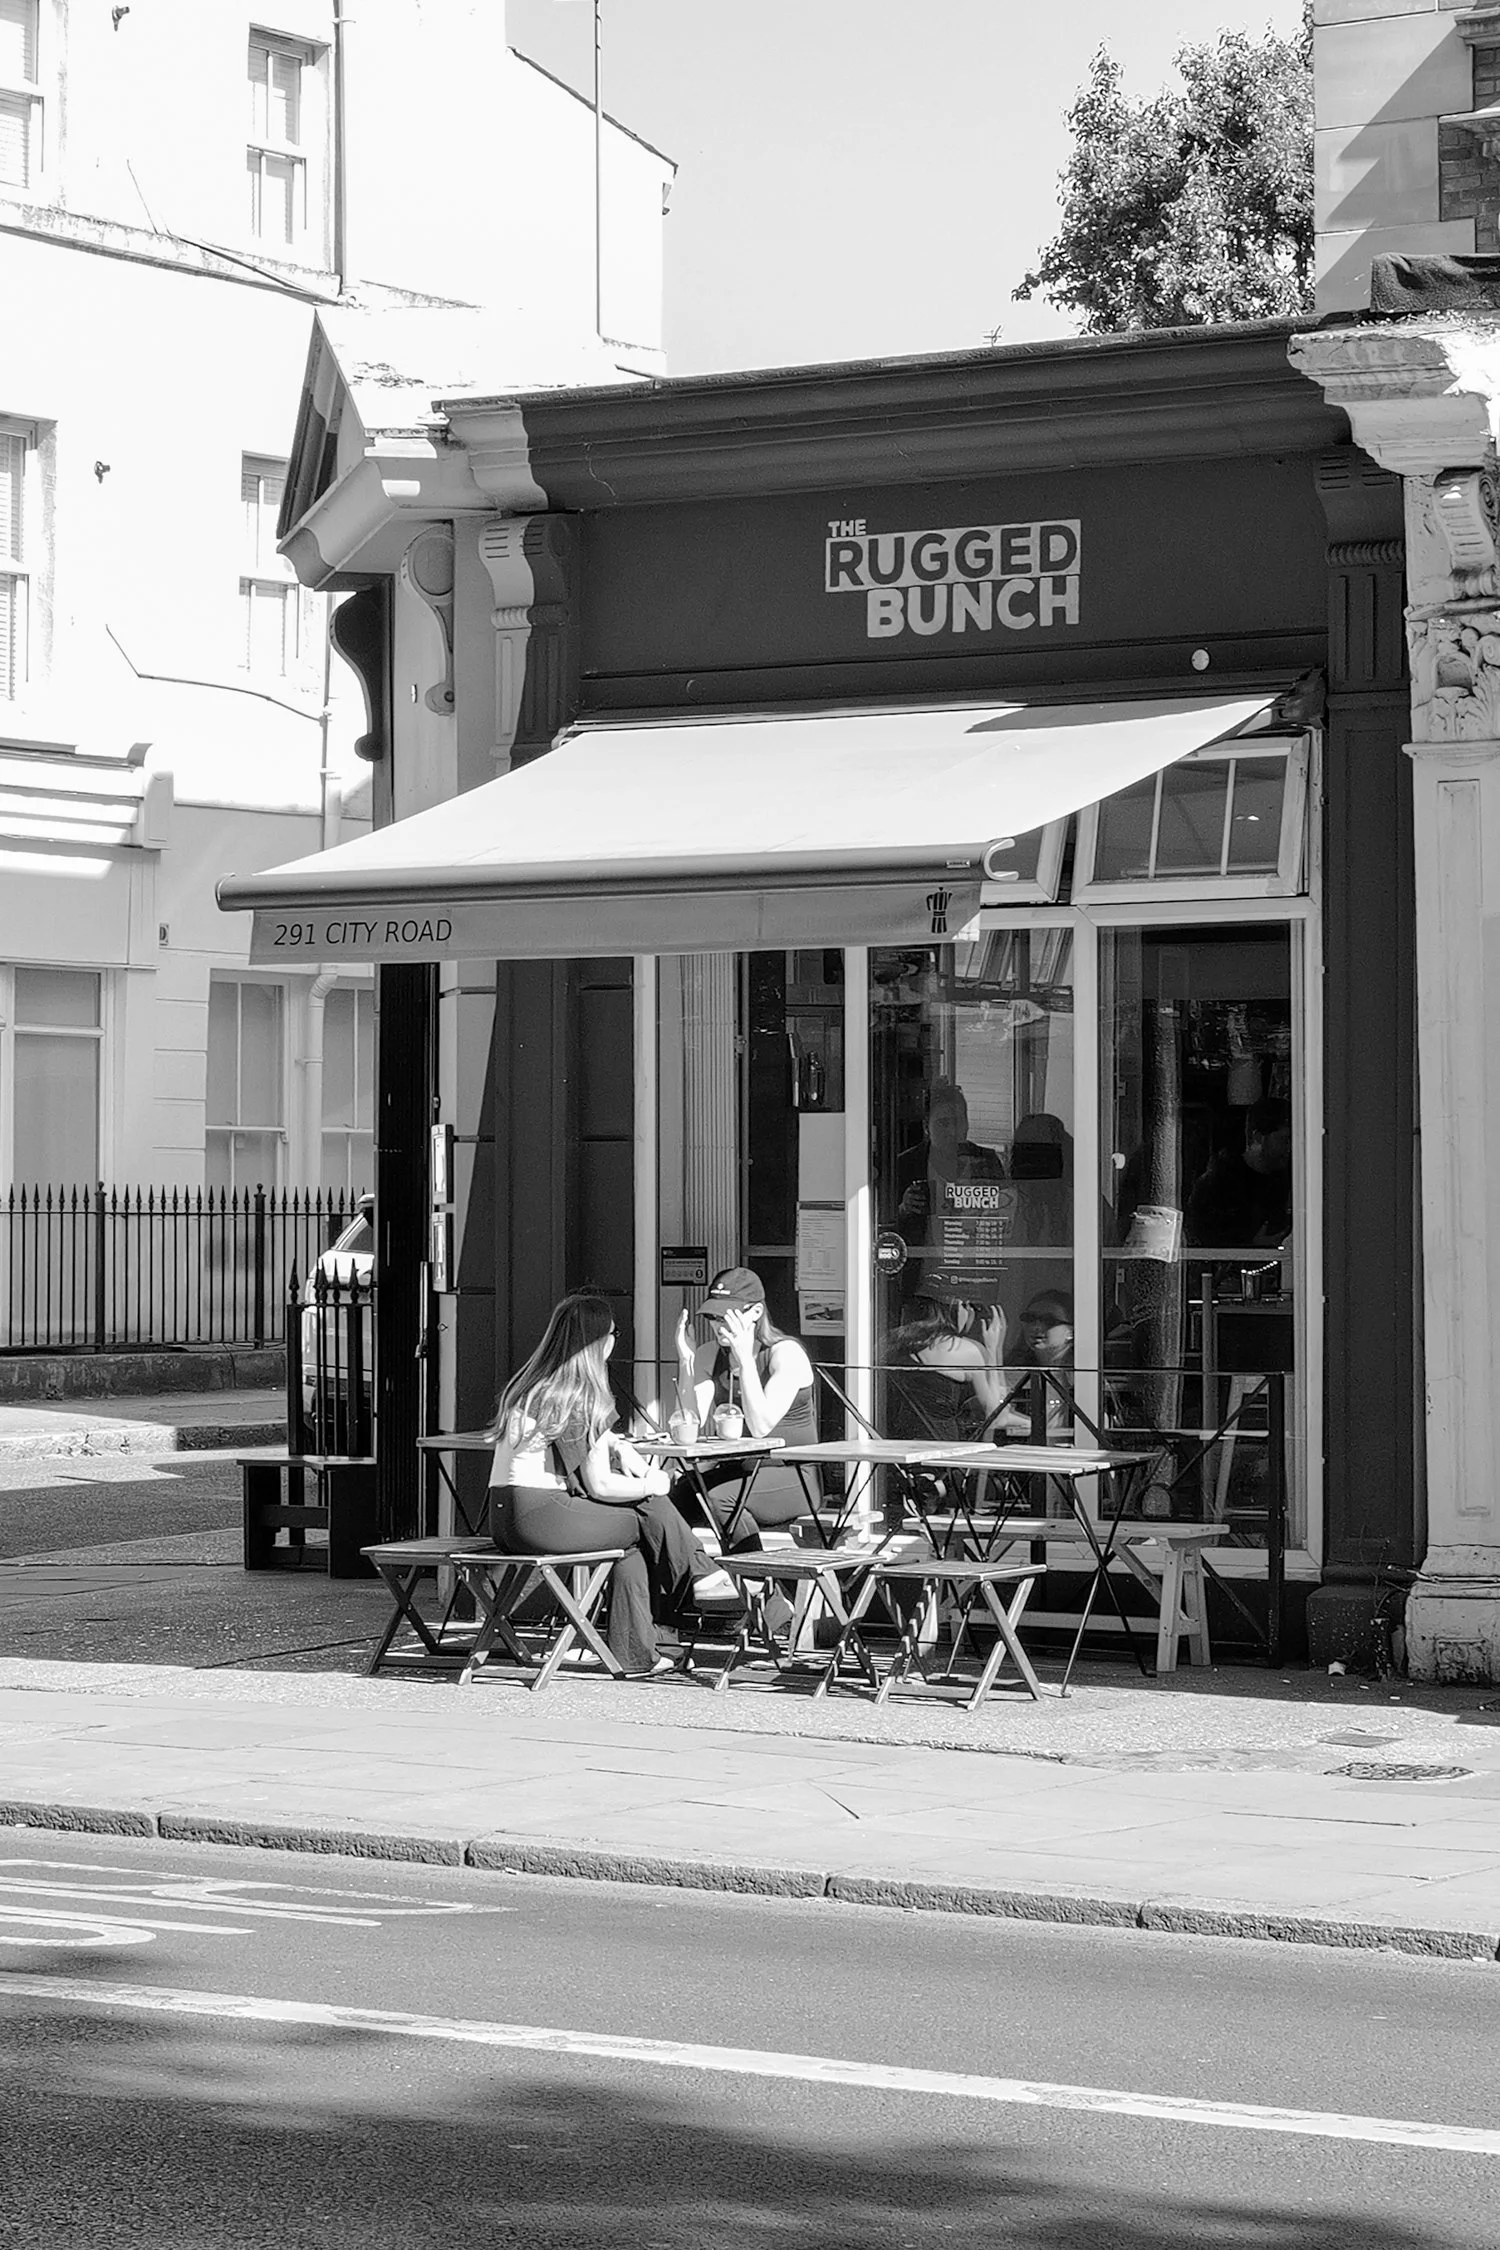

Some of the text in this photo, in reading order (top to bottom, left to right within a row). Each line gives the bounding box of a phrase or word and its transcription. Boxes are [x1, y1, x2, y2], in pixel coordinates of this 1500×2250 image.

[828, 519, 866, 537] THE
[828, 522, 1079, 588] RUGGED
[867, 575, 1080, 638] BUNCH
[273, 919, 452, 946] 291 CITY ROAD
[946, 1186, 998, 1197] RUGGED
[954, 1197, 999, 1209] BUNCH
